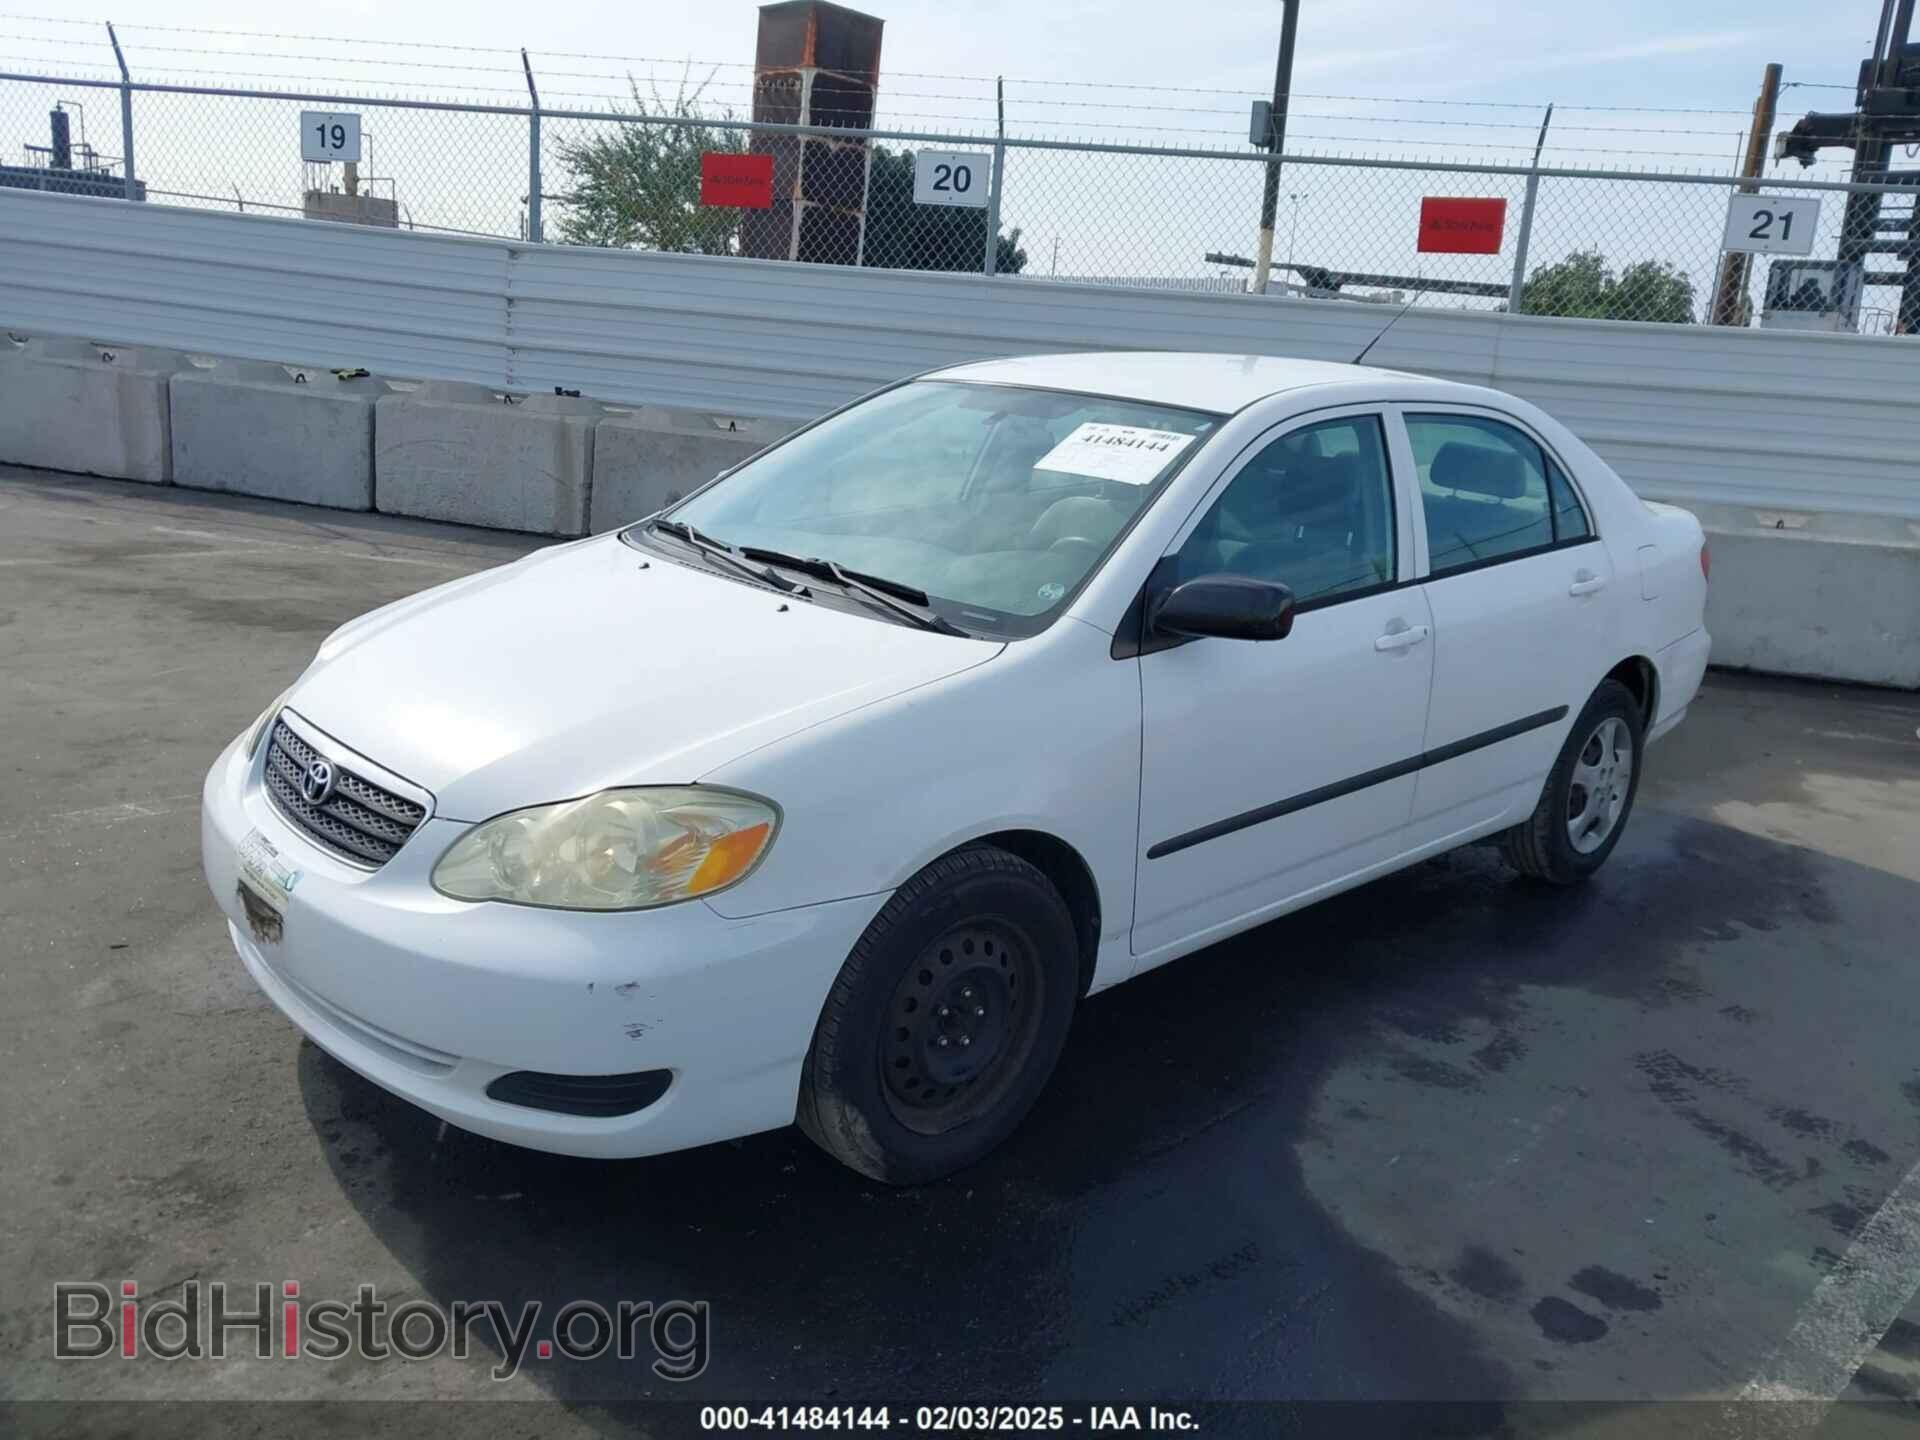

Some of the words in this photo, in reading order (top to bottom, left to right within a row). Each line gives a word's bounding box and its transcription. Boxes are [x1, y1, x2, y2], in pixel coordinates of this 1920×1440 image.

[315, 123, 346, 150] 19
[932, 163, 972, 193] 20
[1748, 209, 1795, 241] 21
[1081, 433, 1170, 453] 41484144
